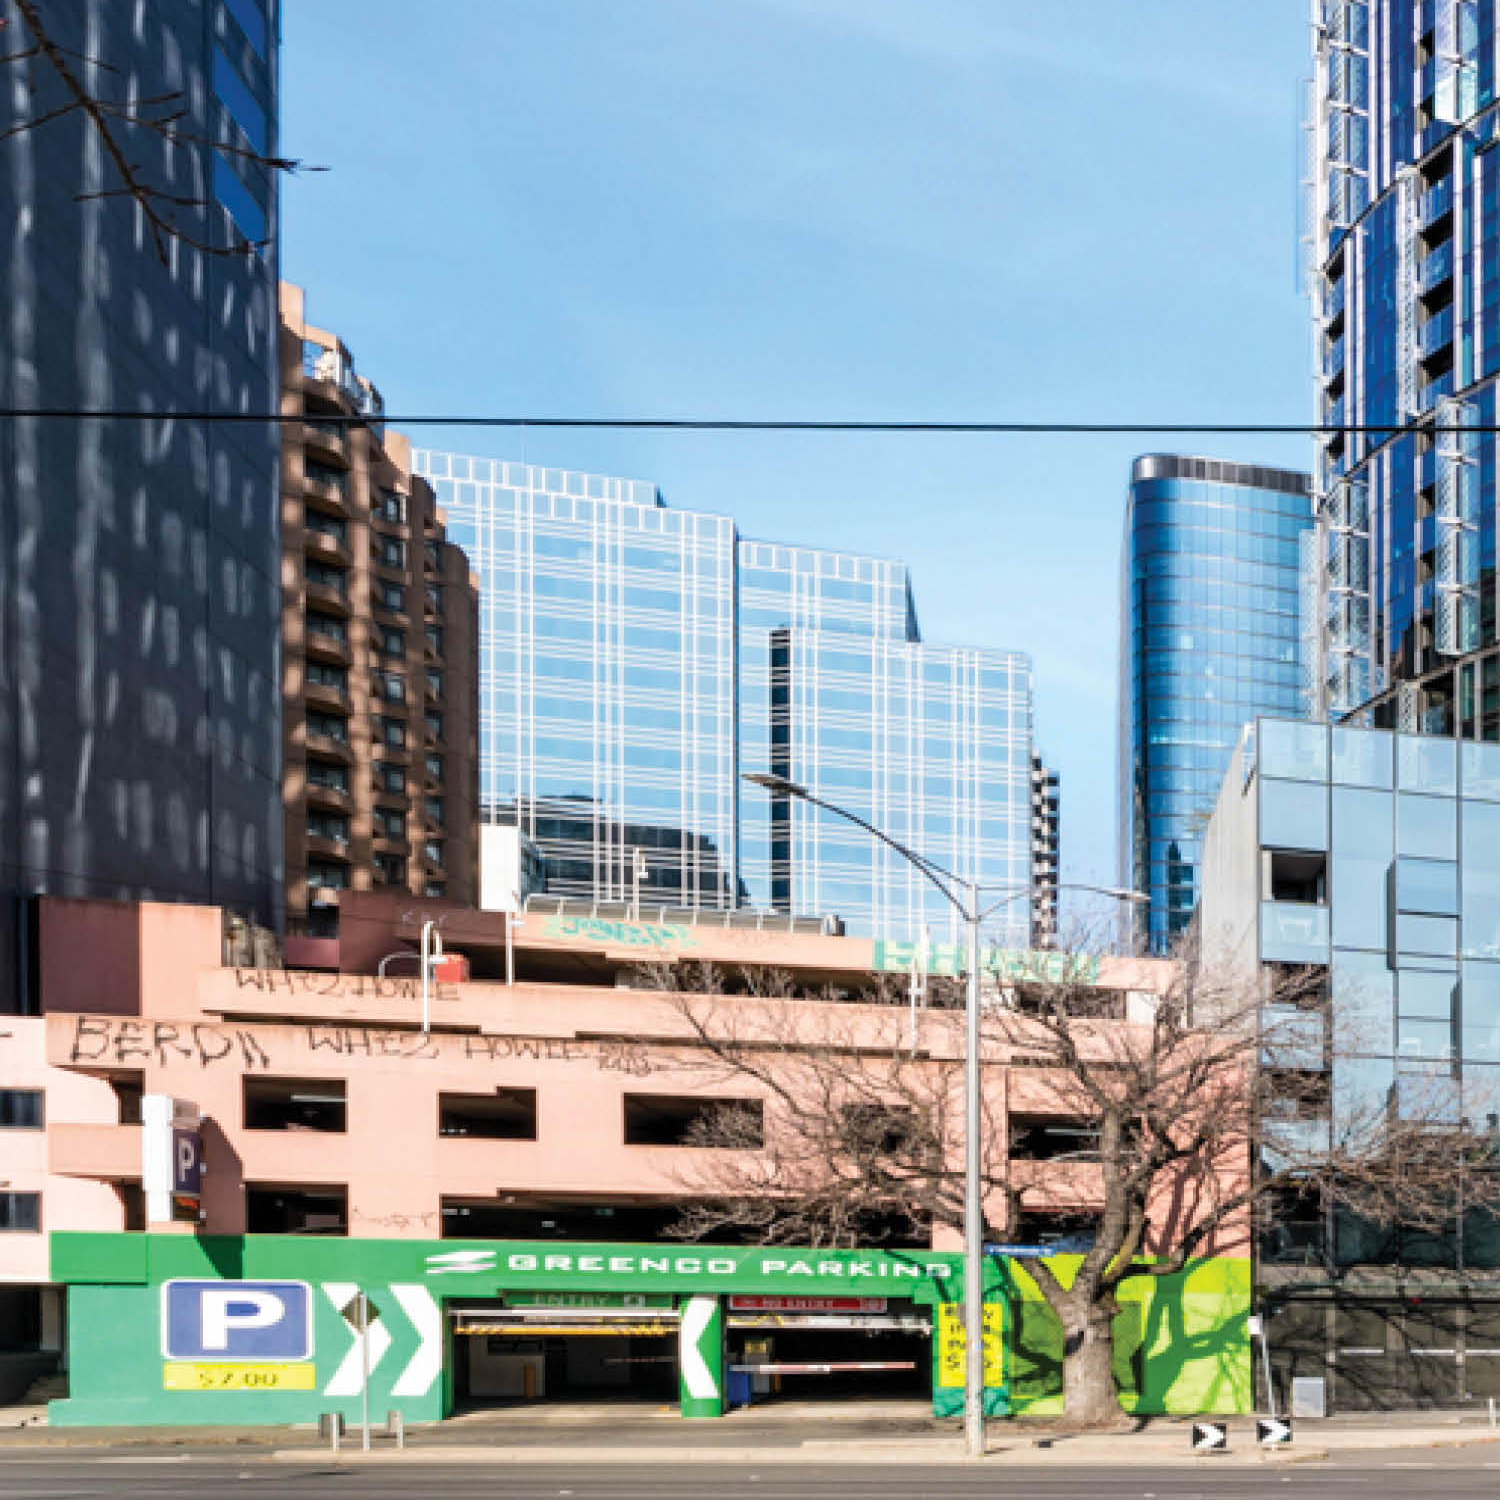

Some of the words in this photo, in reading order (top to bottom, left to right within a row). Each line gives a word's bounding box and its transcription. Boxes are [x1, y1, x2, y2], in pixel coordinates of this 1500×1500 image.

[178, 1138, 195, 1182] P
[508, 1254, 737, 1275] GREENCO
[761, 1260, 952, 1277] PARKING
[202, 1290, 286, 1350] P
